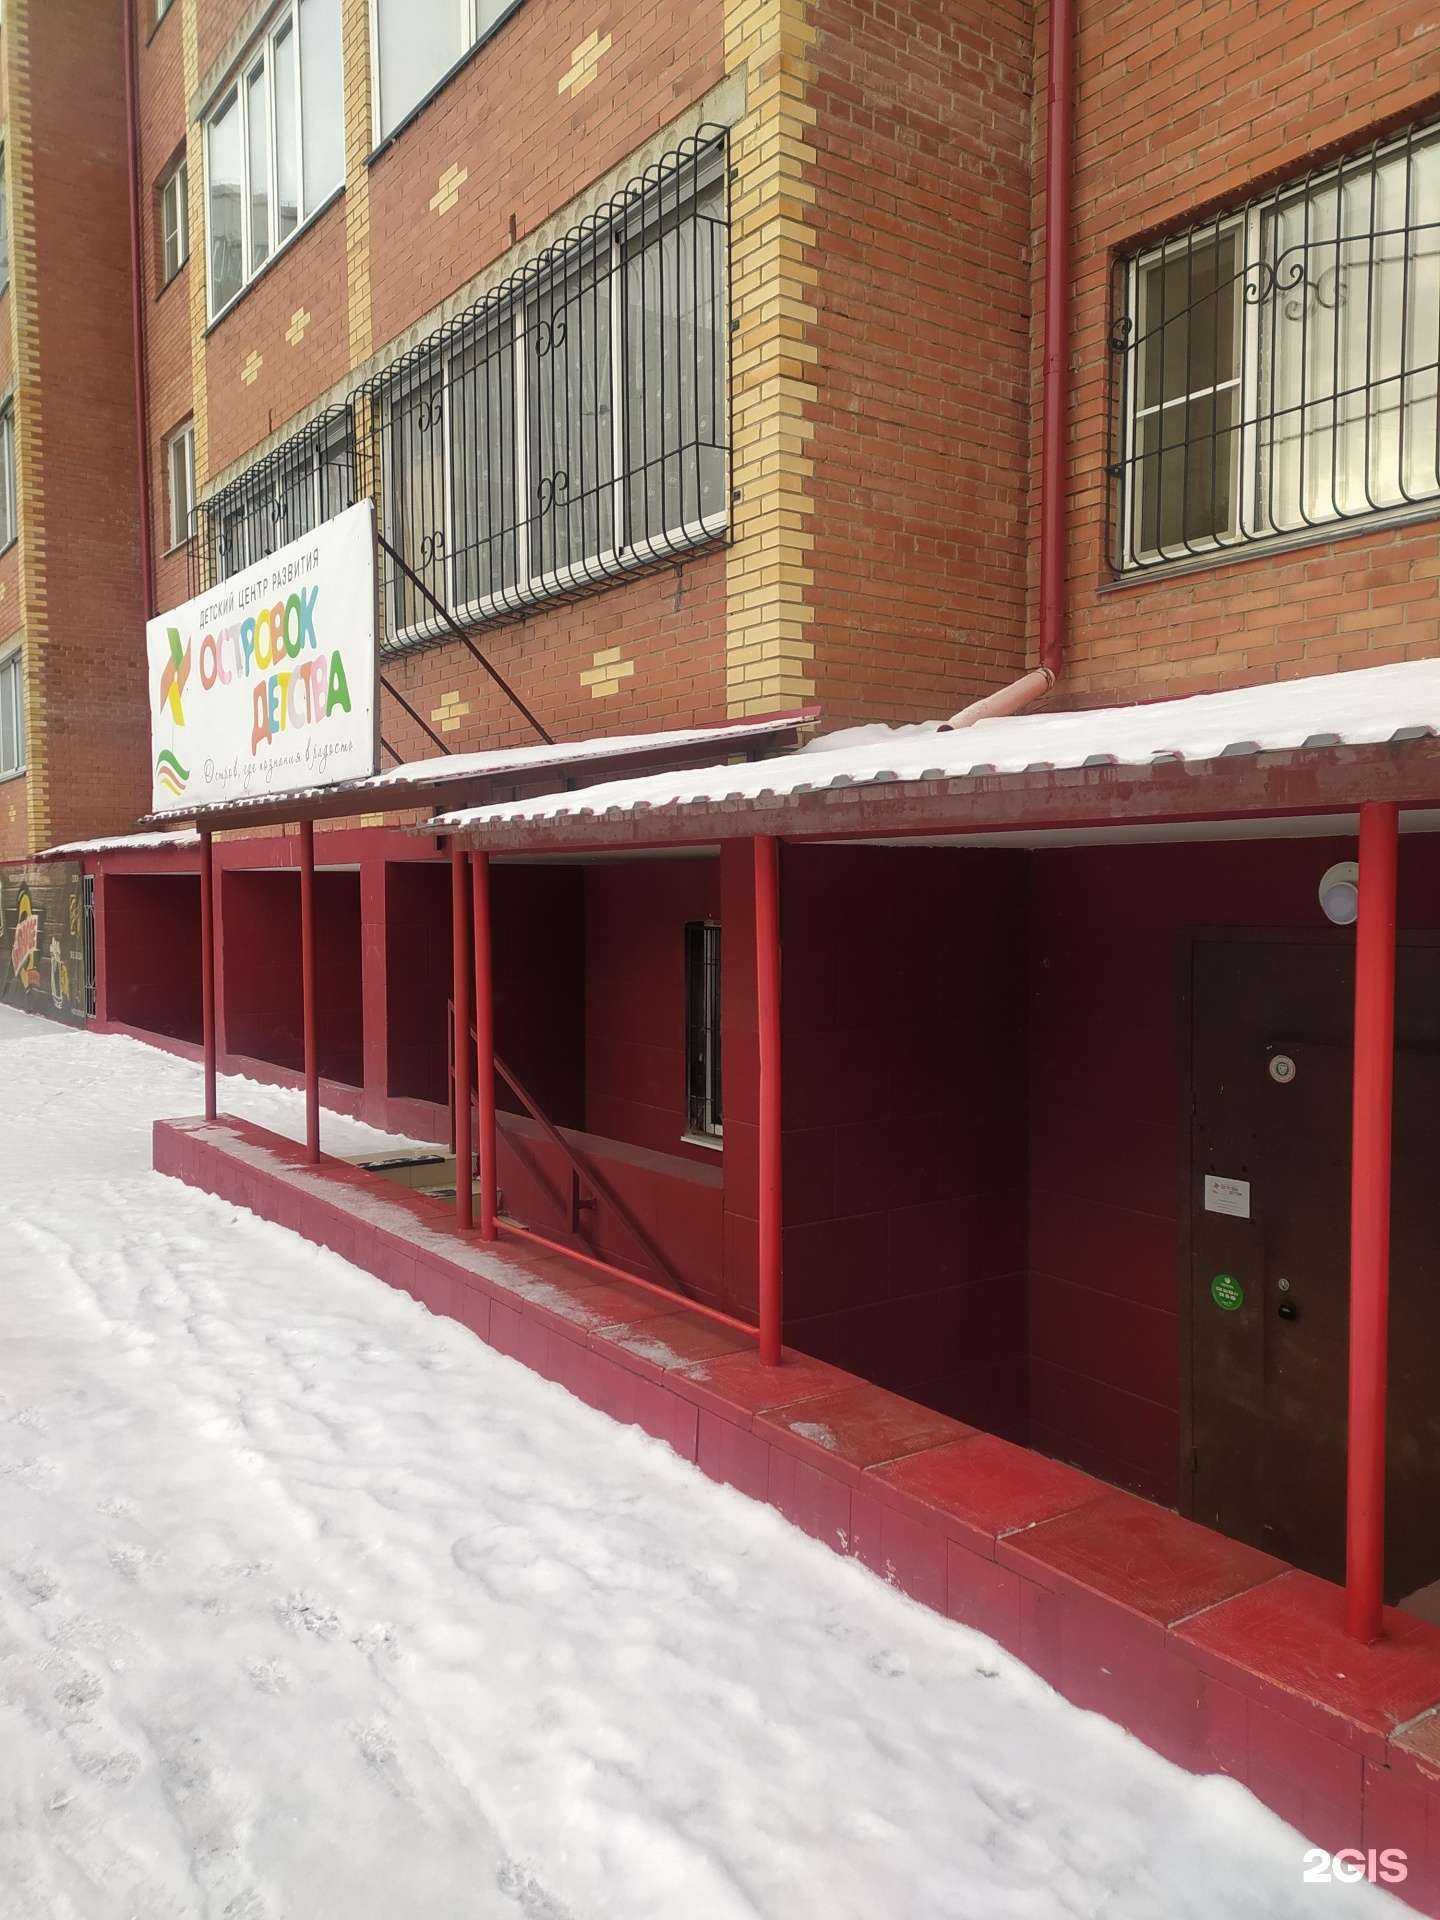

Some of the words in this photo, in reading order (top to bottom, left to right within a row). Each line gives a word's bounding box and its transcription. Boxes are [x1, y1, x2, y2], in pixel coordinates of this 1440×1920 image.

[199, 585, 319, 690] ОСТРОВОК
[200, 592, 234, 630] ДЕТСКИЙ
[238, 578, 268, 611] ЦЕНТР
[272, 548, 319, 591] РАЗВИТИЯ
[252, 650, 351, 756] ДЕТСТВА
